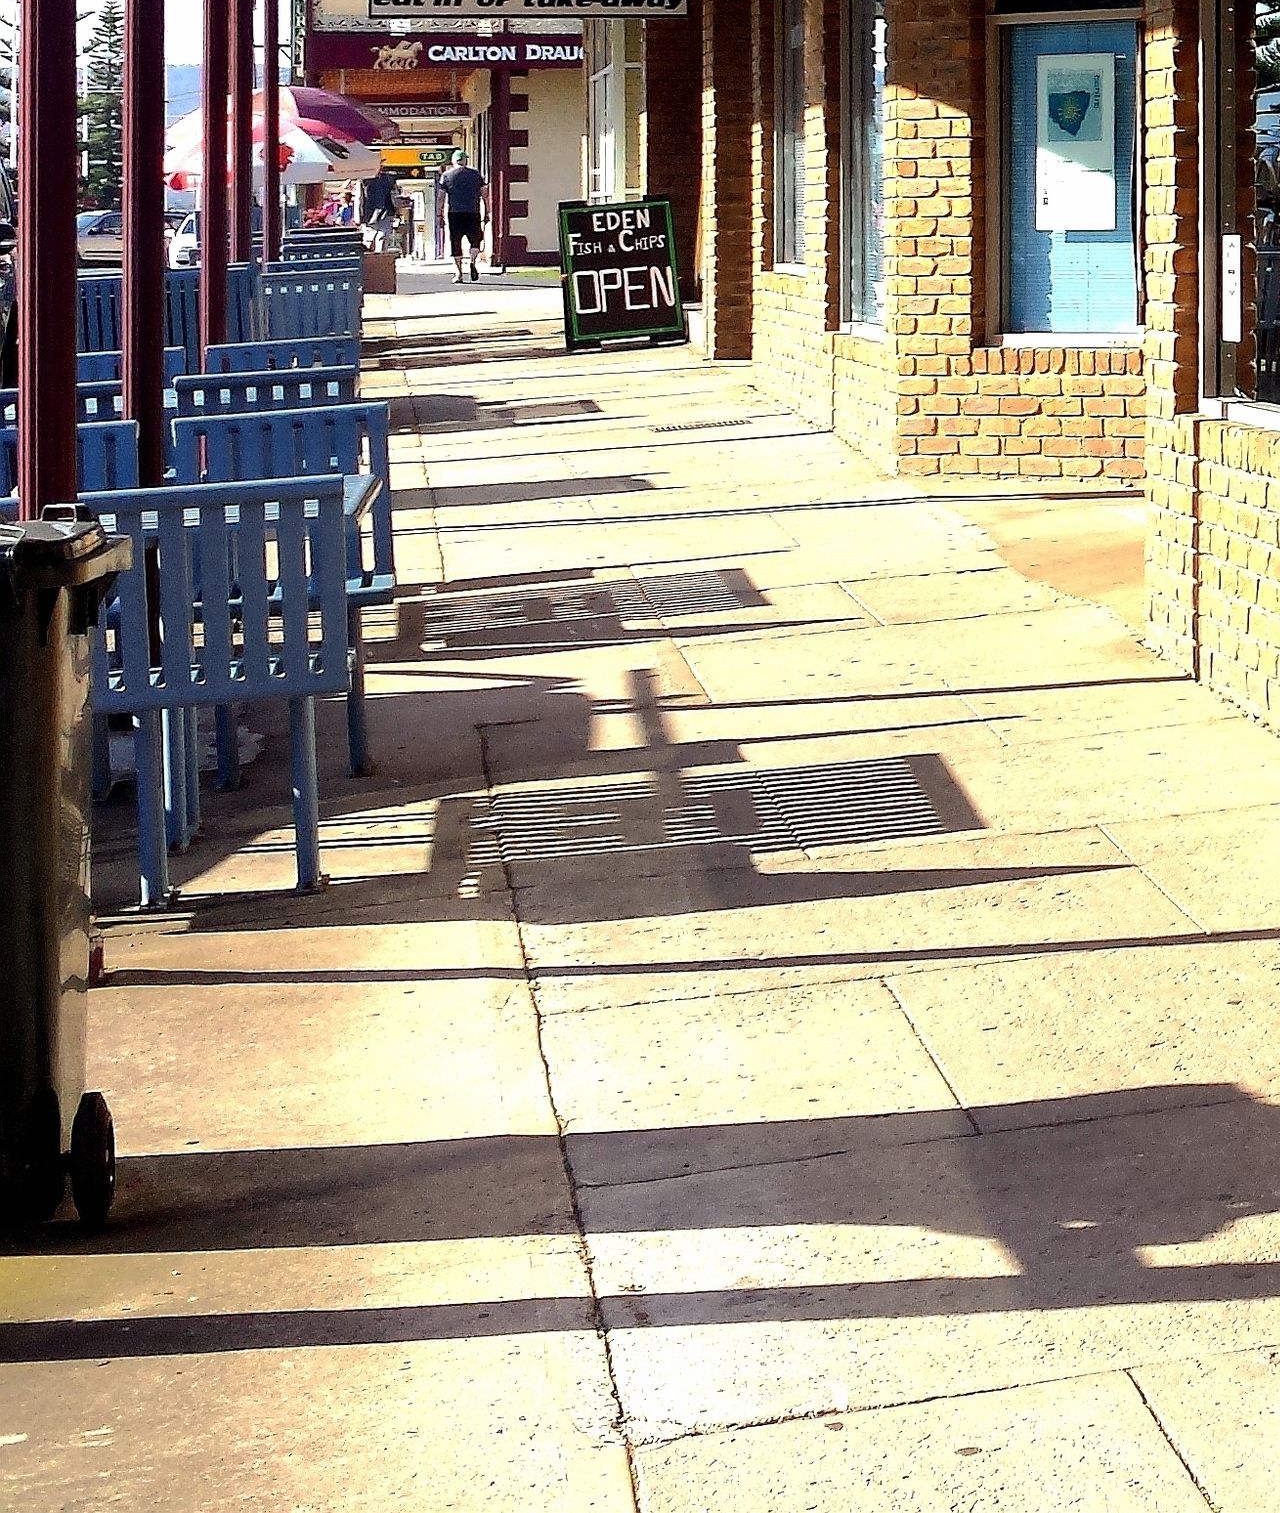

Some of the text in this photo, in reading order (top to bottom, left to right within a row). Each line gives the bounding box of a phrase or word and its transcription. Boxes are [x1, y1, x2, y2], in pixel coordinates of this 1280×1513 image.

[428, 45, 517, 62] CARLTON
[377, 106, 457, 116] MMODATION
[592, 209, 651, 232] EDEN
[568, 233, 602, 256] FISH
[618, 230, 666, 252] CHIPS
[572, 266, 676, 314] OPEN
